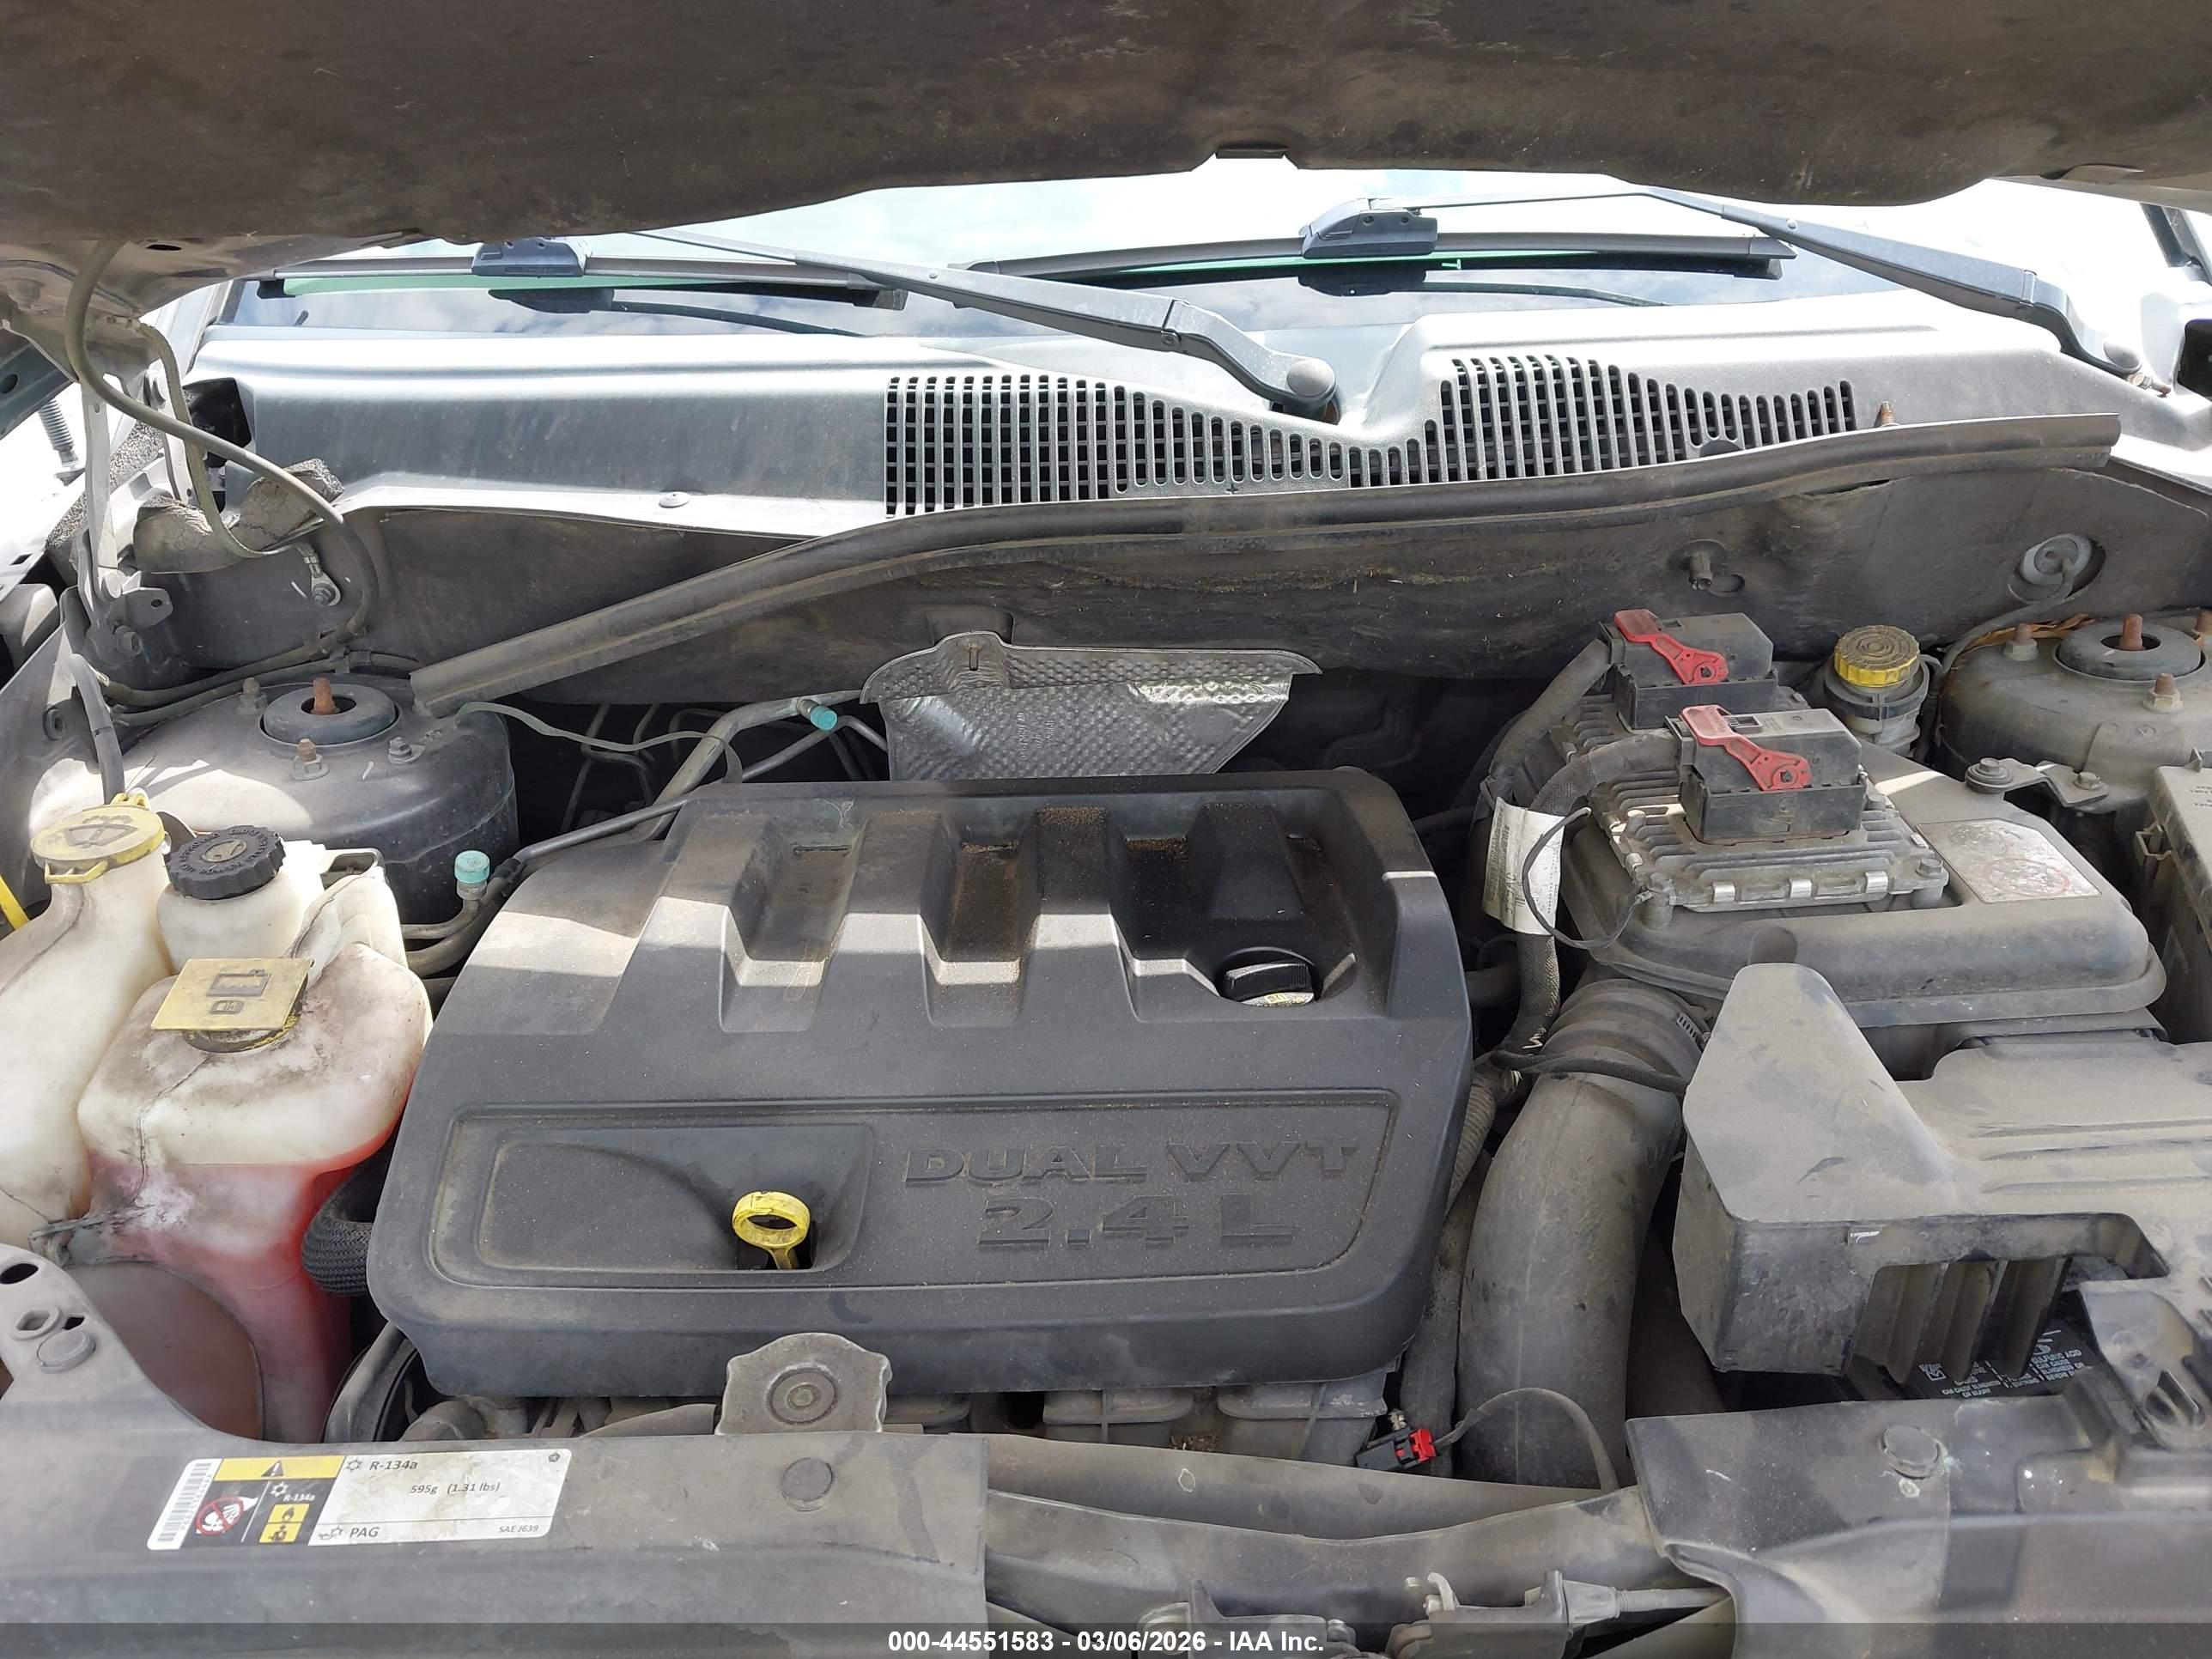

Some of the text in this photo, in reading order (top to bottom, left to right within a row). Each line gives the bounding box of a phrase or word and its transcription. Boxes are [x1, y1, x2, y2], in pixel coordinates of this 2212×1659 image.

[905, 1139, 1358, 1185] DUAL VVT
[2064, 1349, 2082, 1358] ACID
[369, 1460, 418, 1471] R-134a
[410, 1481, 501, 1495] 595g (1.31 lbs)
[349, 1526, 380, 1539] PAG
[499, 1524, 539, 1534] SAE J639
